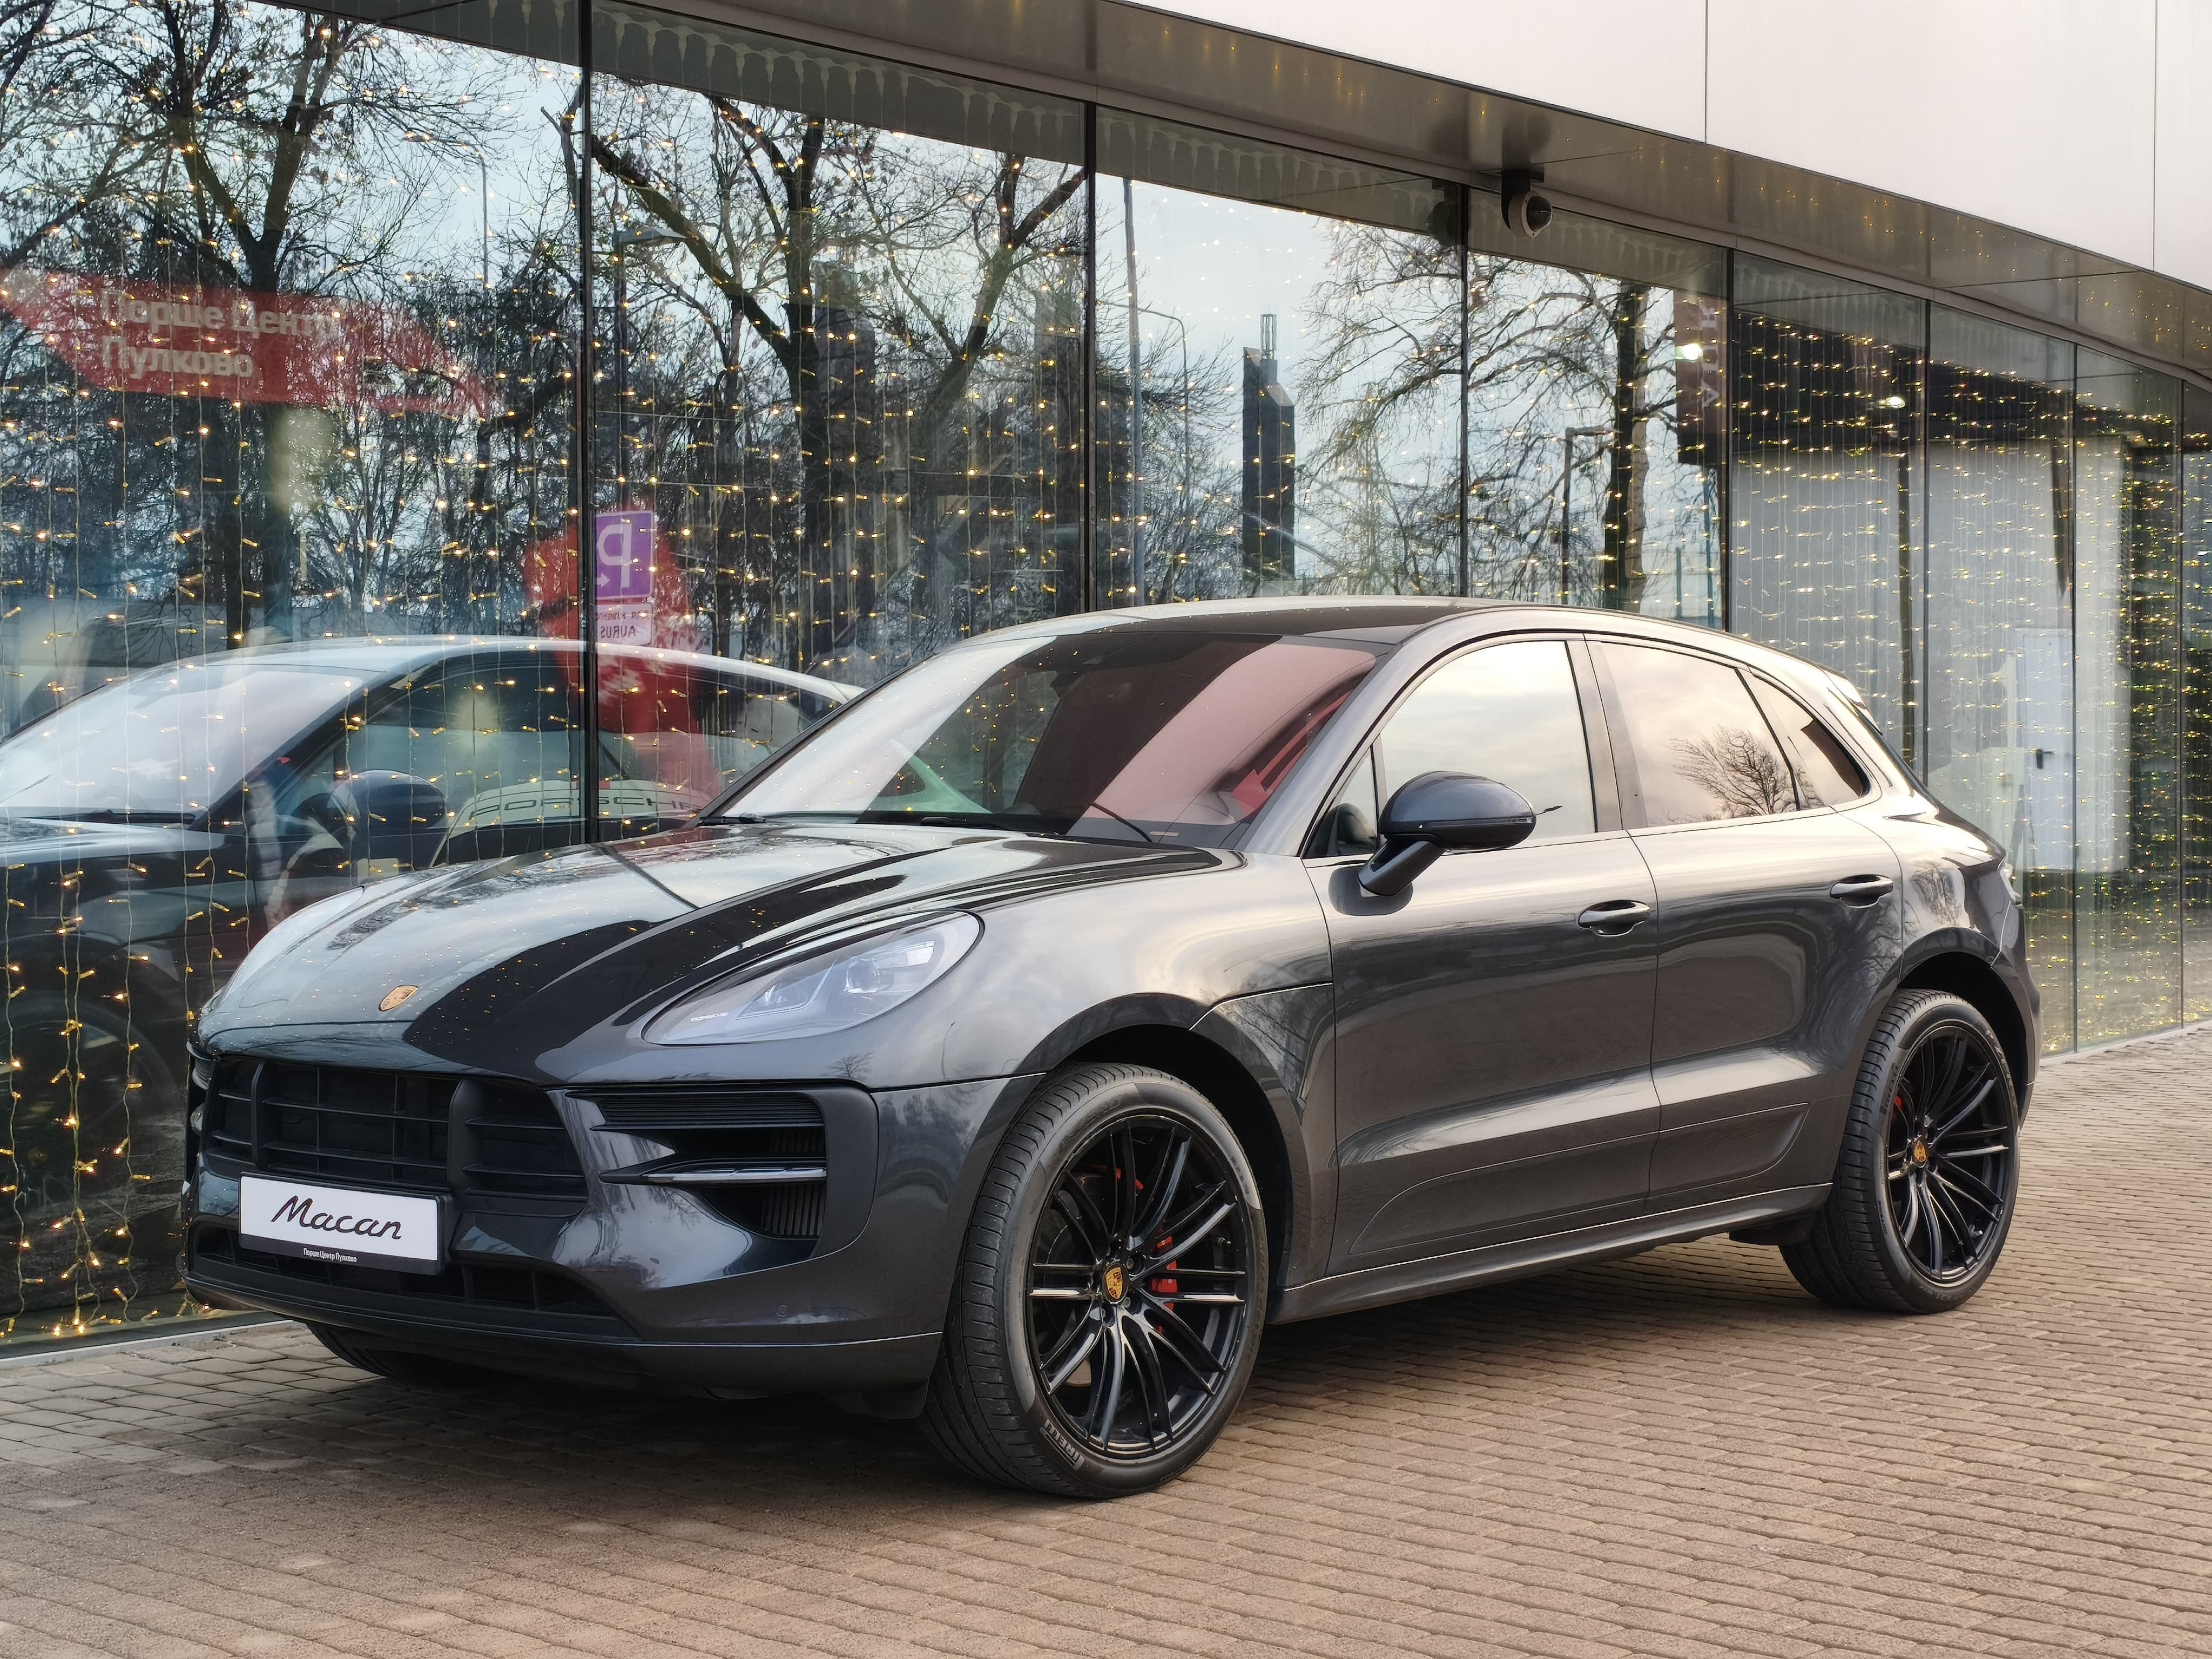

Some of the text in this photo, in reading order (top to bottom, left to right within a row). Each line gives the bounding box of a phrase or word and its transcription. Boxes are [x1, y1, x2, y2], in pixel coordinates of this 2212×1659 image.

[101, 288, 225, 332] Порше
[102, 335, 254, 379] Пулково
[271, 1195, 401, 1239] Macan
[320, 1250, 335, 1261] Центр
[335, 1252, 357, 1263] Пулково
[1040, 1419, 1085, 1470] PIRELLI
